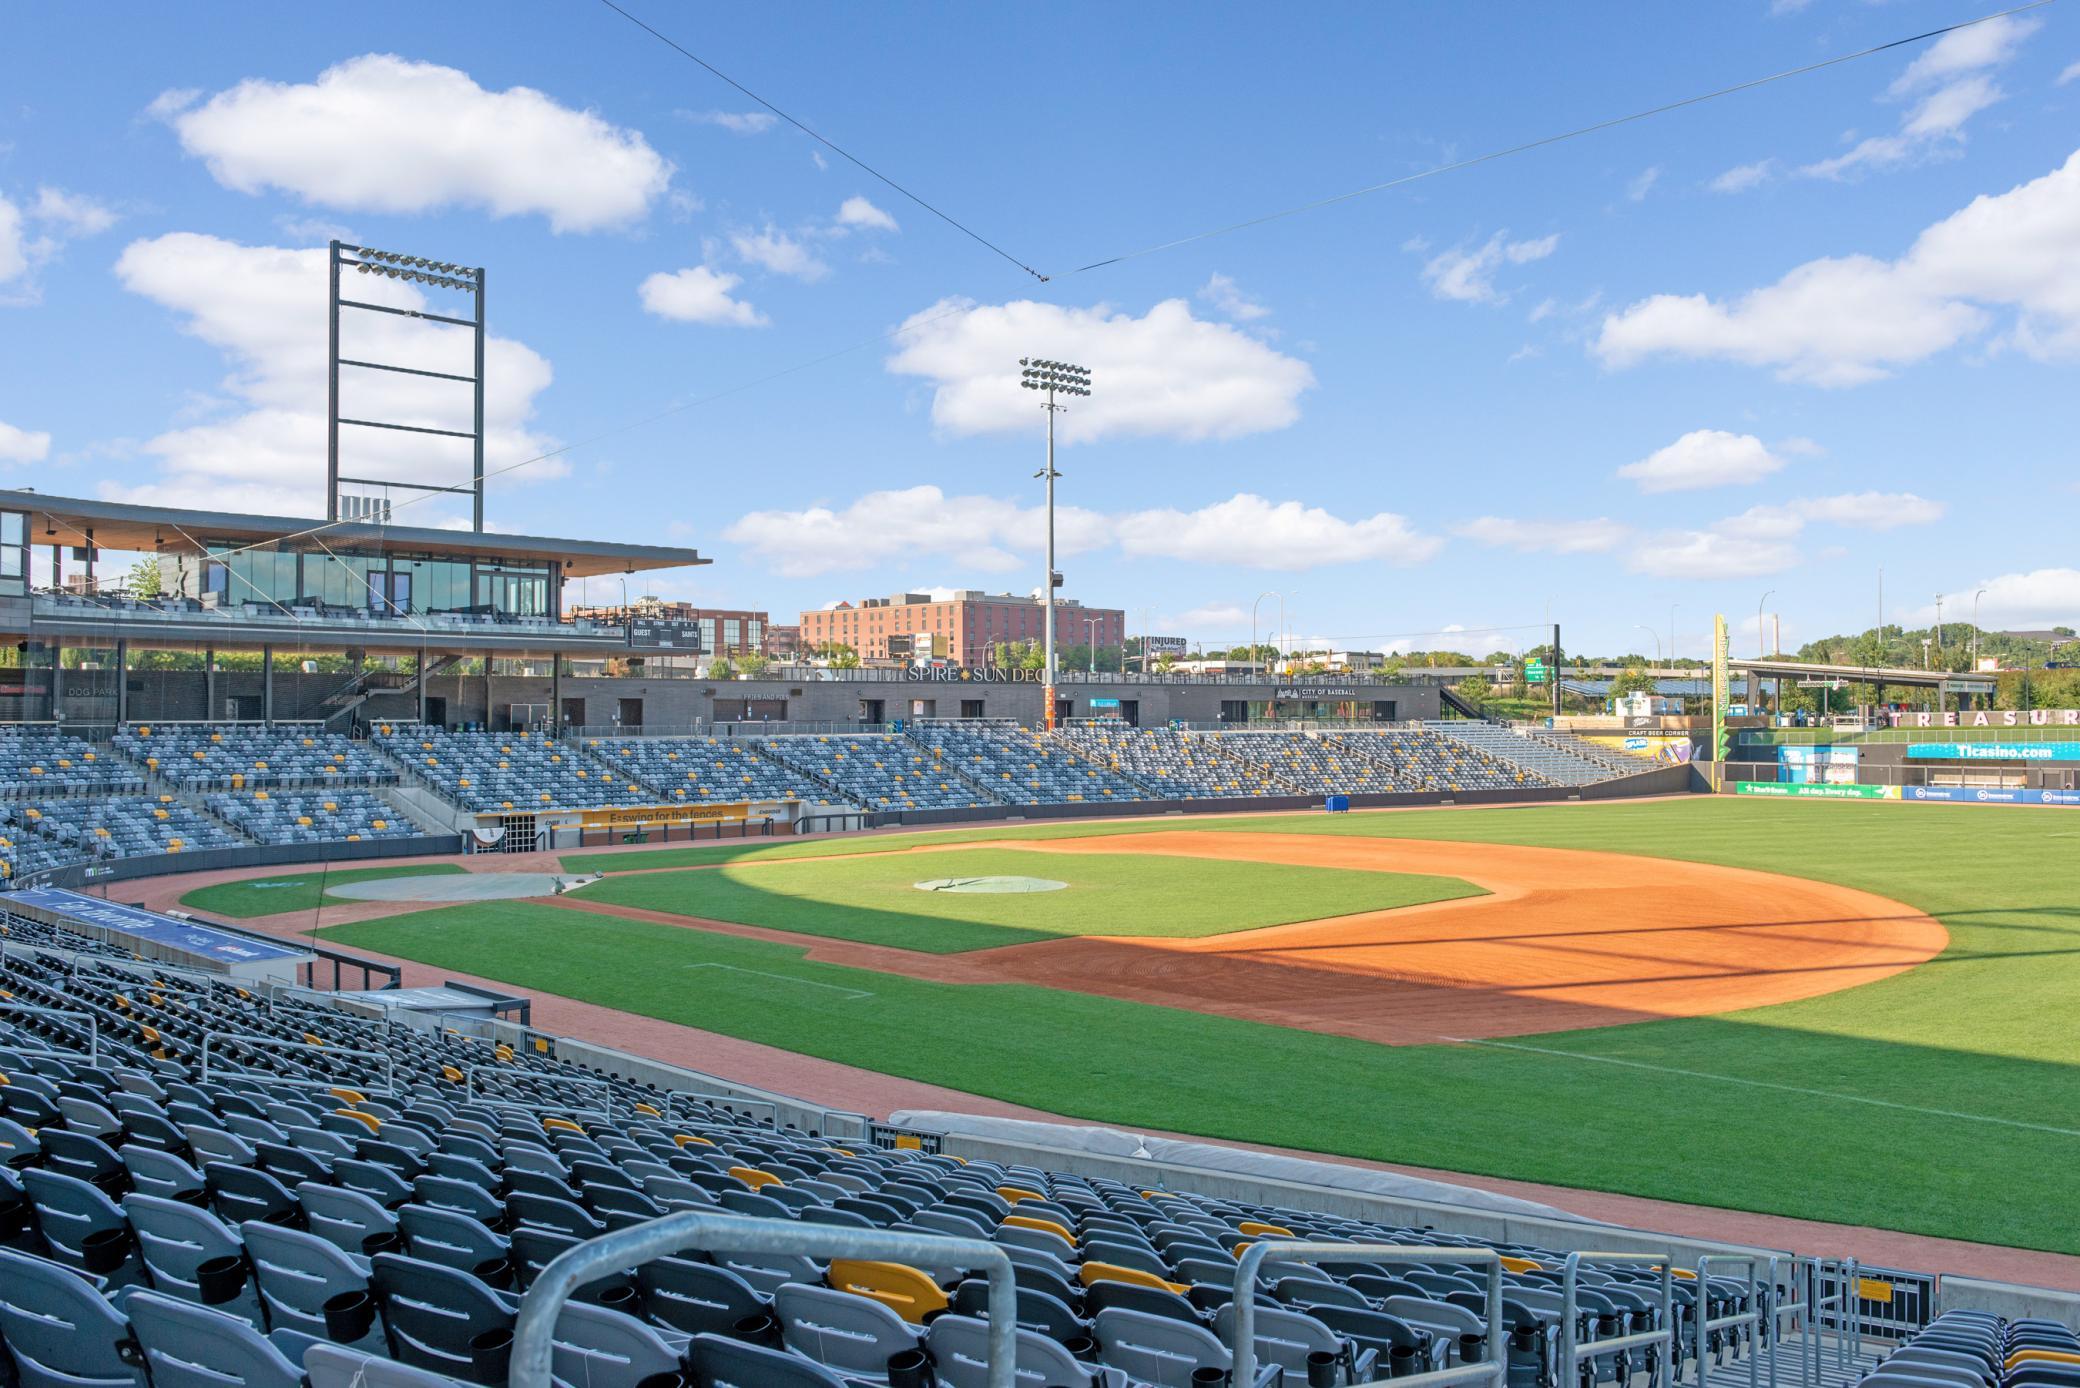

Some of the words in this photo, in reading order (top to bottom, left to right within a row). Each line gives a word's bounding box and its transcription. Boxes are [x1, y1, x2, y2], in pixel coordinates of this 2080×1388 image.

[633, 628, 651, 636] GUEST
[1151, 636, 1187, 647] INJURED
[908, 667, 959, 682] SPIRE
[973, 668, 1007, 682] SUN
[1012, 668, 1047, 682] DEC
[68, 688, 90, 696] DOG
[93, 687, 118, 696] PARK
[655, 810, 670, 821] for
[671, 809, 689, 821] the
[690, 808, 723, 819] fences
